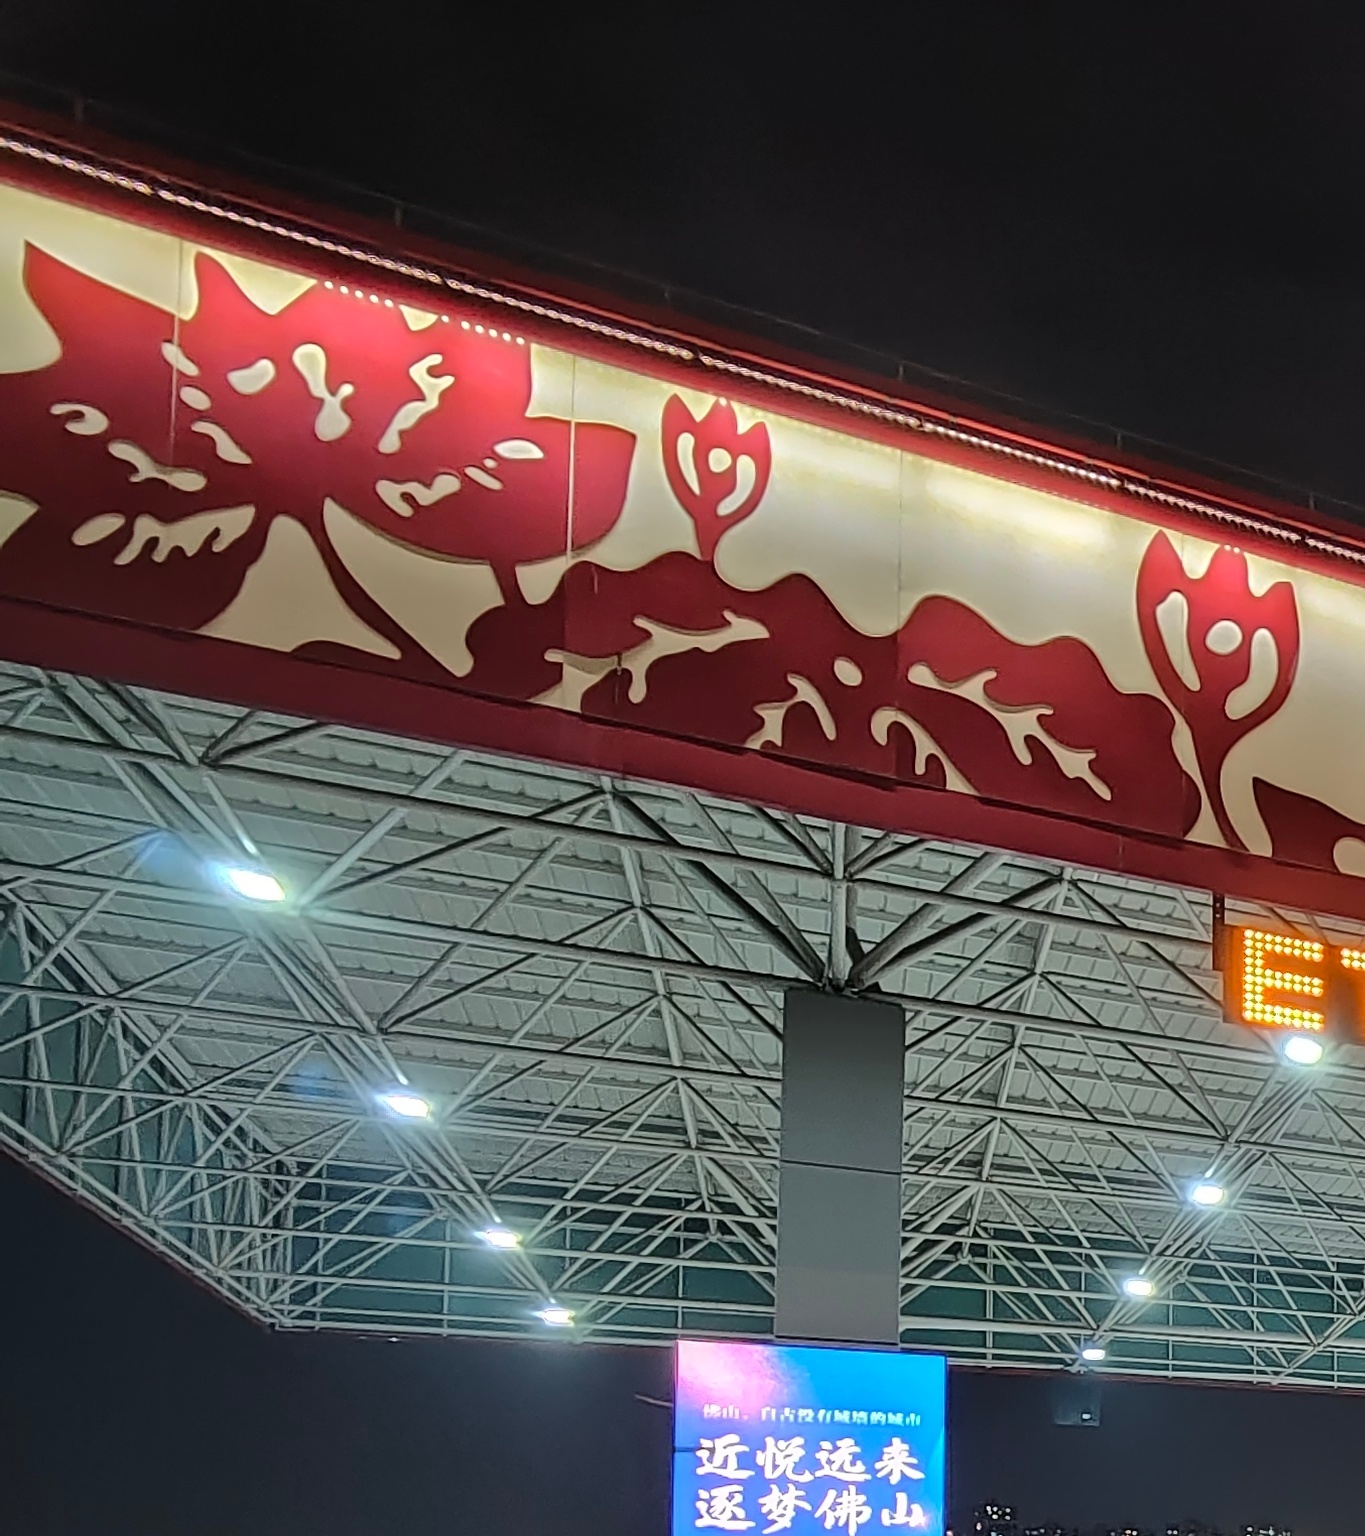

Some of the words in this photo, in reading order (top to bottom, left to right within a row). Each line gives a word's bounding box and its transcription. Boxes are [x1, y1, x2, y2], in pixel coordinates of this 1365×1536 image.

[695, 1433, 926, 1485] 近悦远来
[695, 1483, 928, 1536] 逐梦佛山
